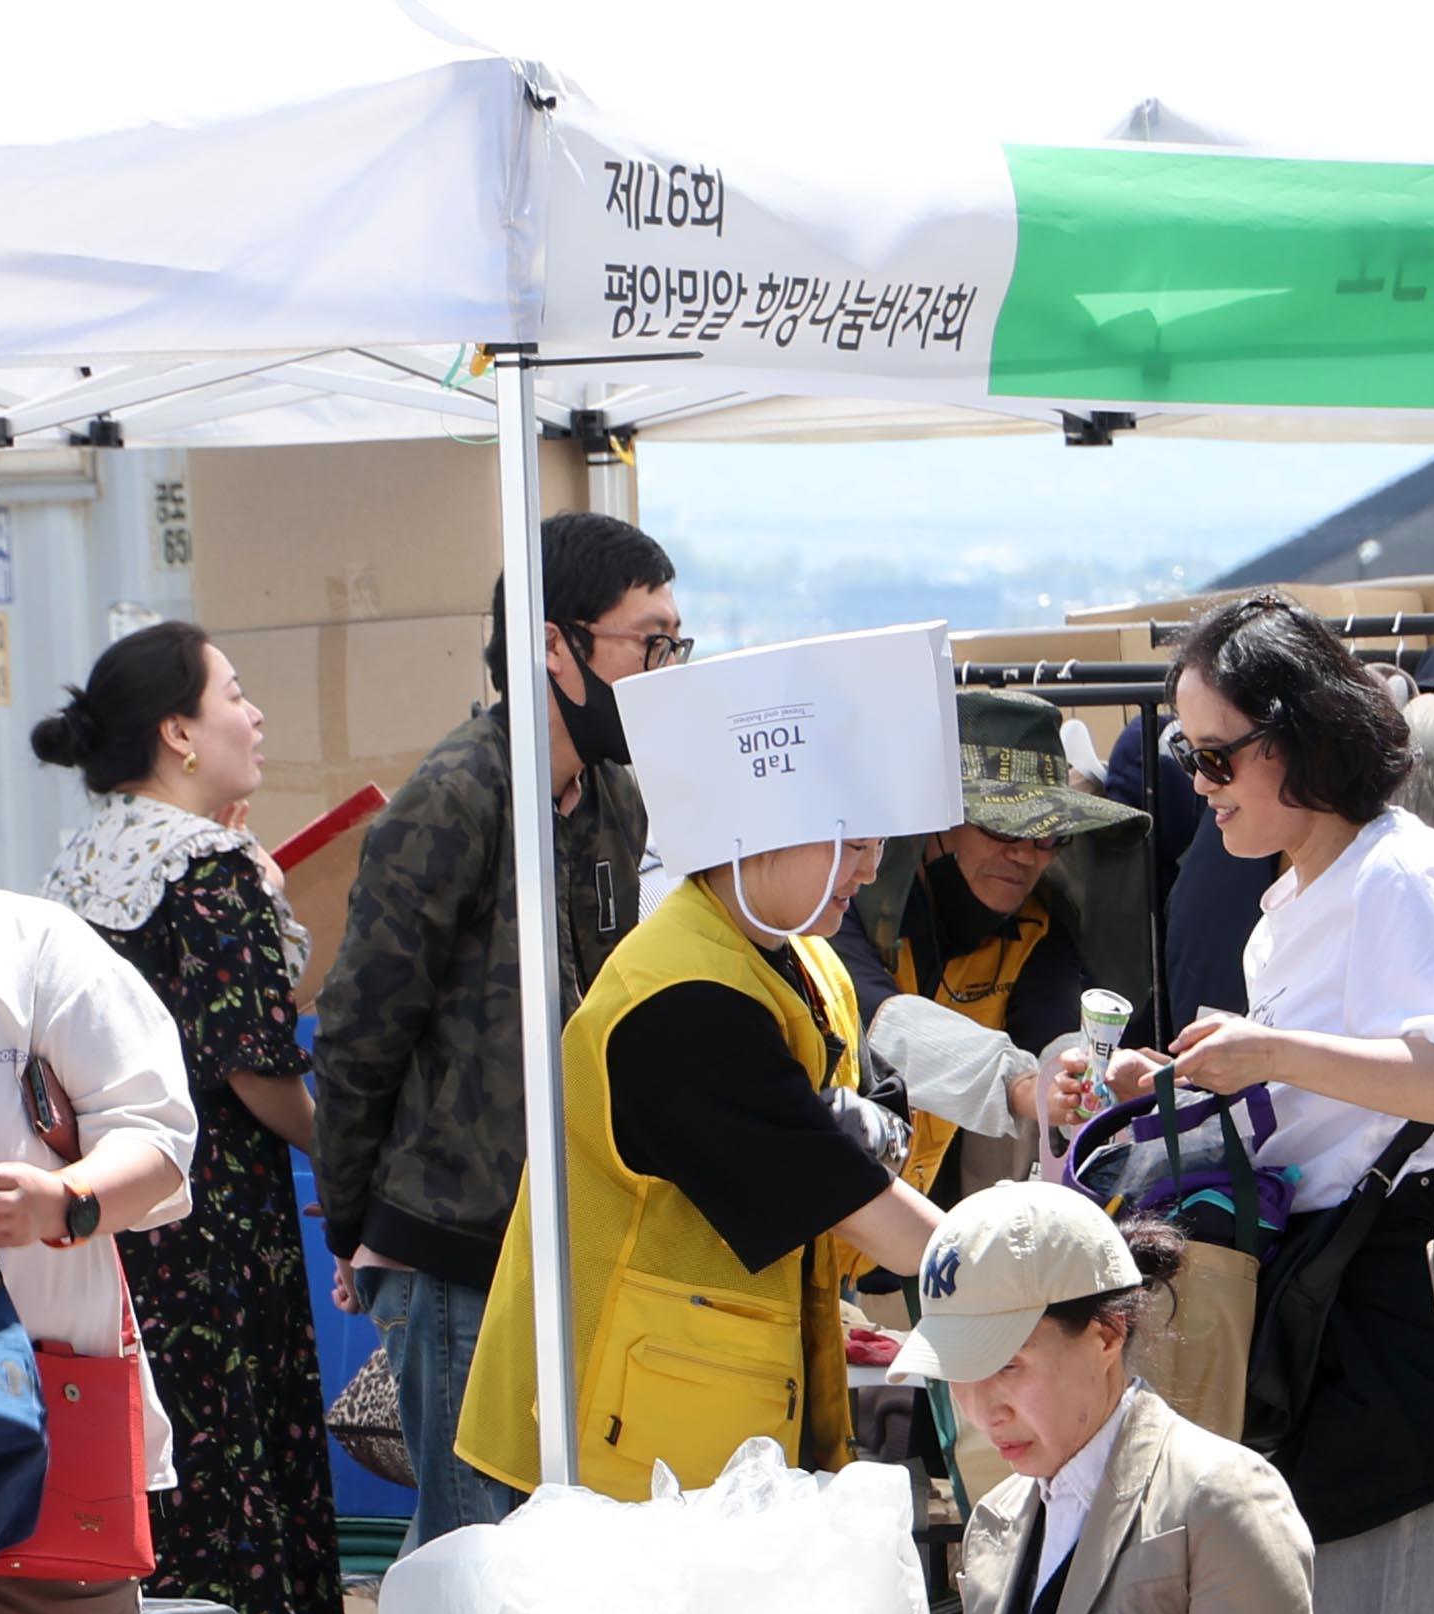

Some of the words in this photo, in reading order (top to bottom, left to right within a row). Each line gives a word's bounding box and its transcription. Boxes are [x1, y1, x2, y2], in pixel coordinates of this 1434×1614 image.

[603, 159, 725, 237] 제16회
[603, 262, 749, 342] 평안밀알
[741, 271, 979, 352] 희망나눔바자회
[737, 724, 806, 754] TOUR
[752, 753, 796, 778] TaB
